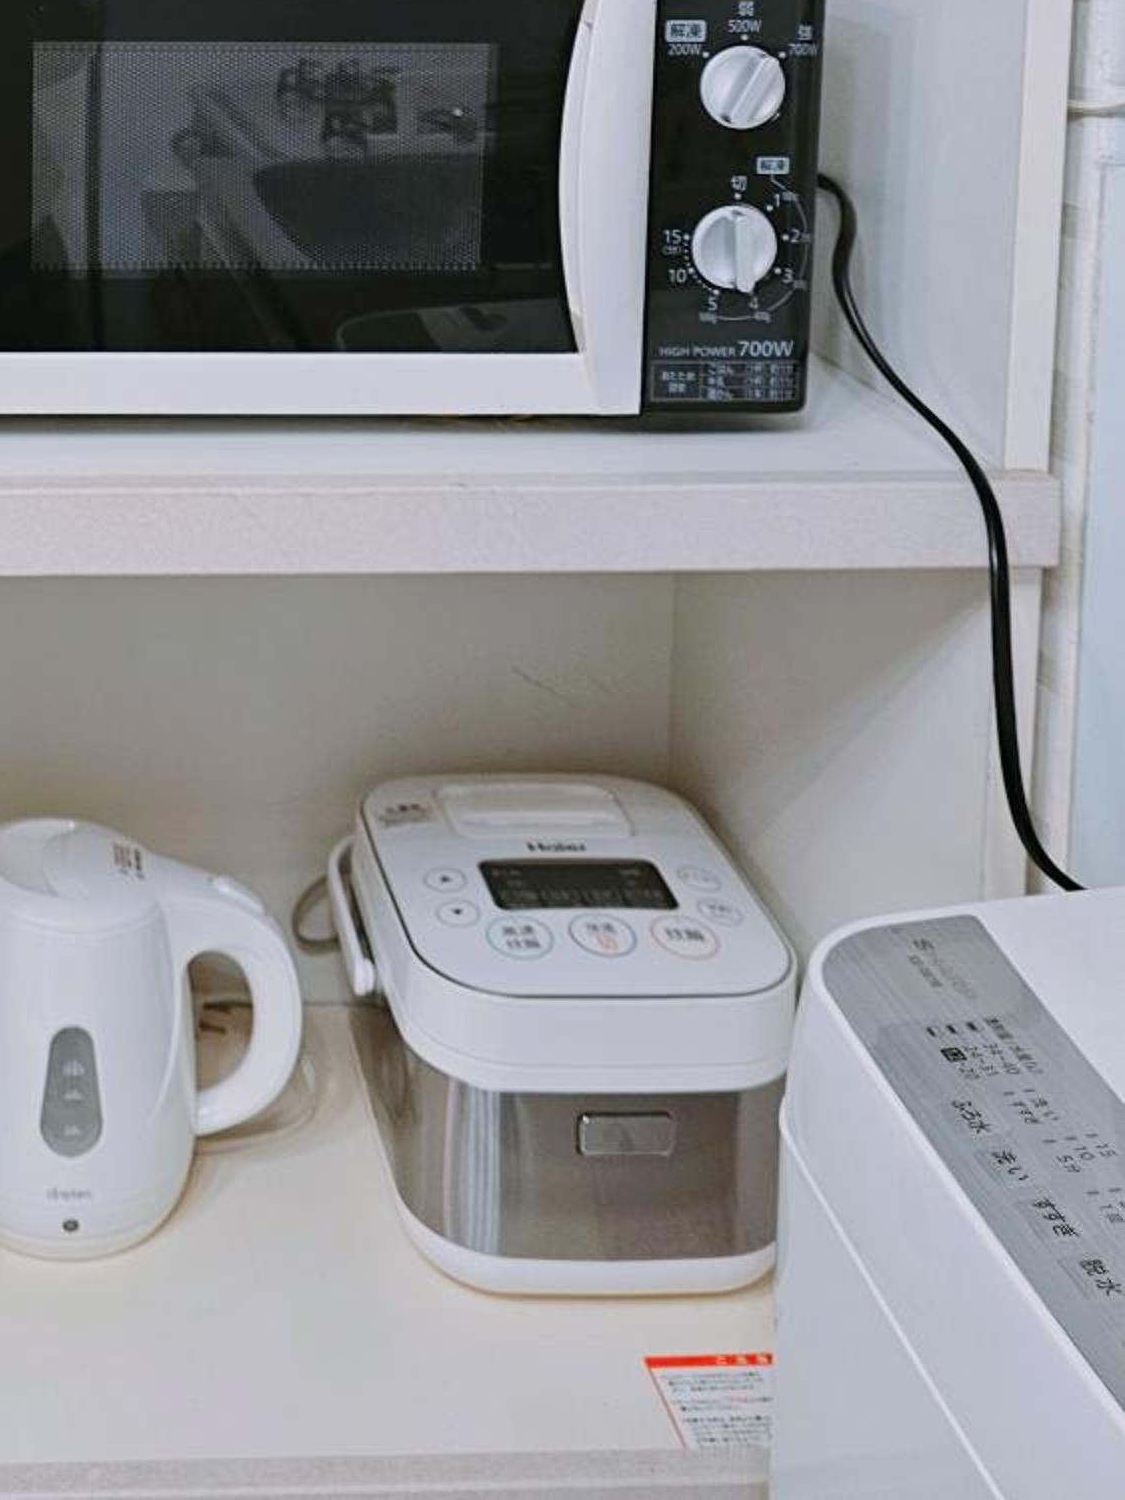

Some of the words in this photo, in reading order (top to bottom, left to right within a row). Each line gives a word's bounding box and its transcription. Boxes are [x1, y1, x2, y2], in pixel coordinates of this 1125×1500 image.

[727, 19, 763, 33] 500W
[668, 44, 703, 56] 200W
[664, 229, 682, 244] 15
[790, 228, 801, 243] 2
[669, 268, 687, 283] 10
[783, 268, 794, 283] 3
[707, 296, 718, 311] 5
[659, 347, 690, 357] HIGH
[692, 347, 736, 357] POWER
[738, 339, 794, 357] 700W
